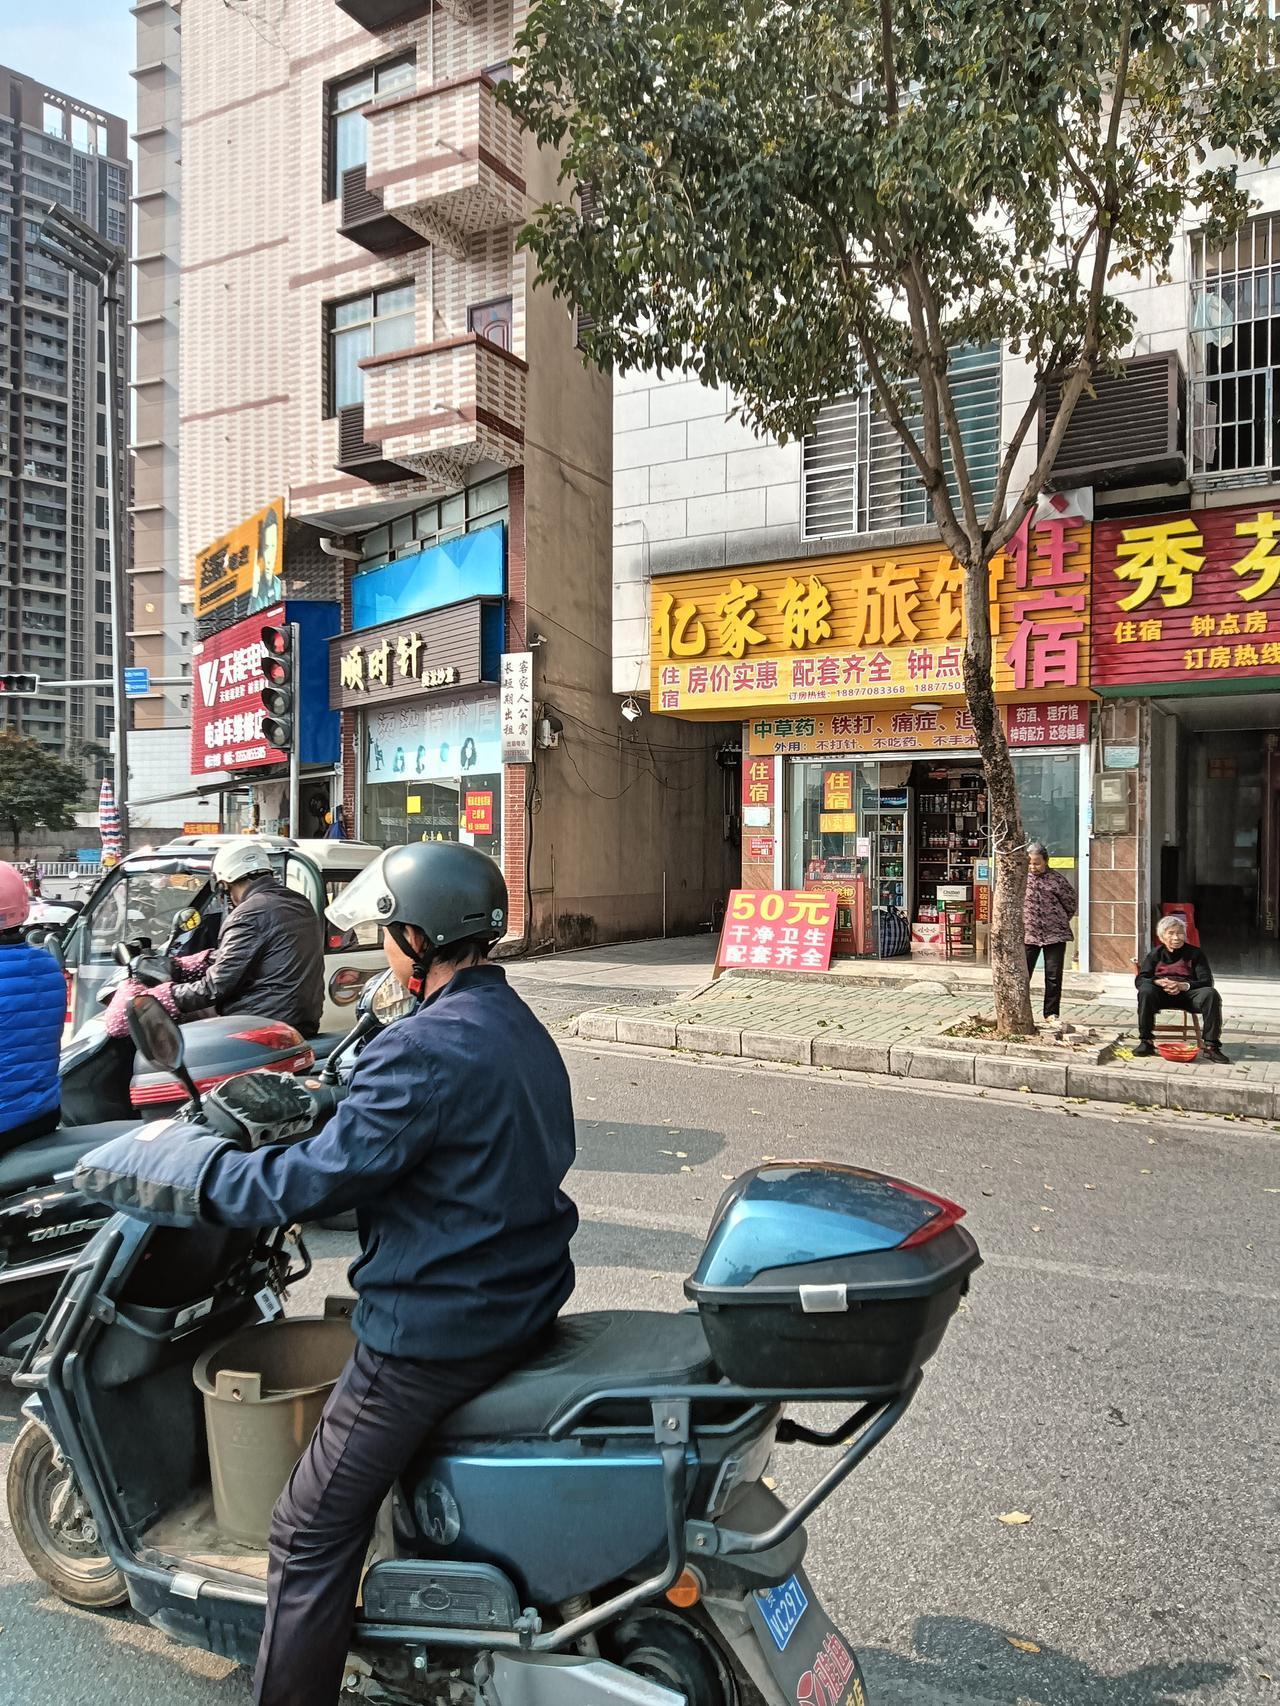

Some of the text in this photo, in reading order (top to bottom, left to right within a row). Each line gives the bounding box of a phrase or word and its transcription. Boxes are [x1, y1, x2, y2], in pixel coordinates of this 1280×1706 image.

[1003, 494, 1085, 688] 住宿
[1113, 610, 1268, 643] 住宿 钟点房
[219, 640, 269, 687] 天能电
[340, 631, 423, 691] 顺时针
[687, 646, 961, 694] 房价实惠 配套齐全 钟点
[1184, 642, 1280, 670] 订房热线
[503, 662, 514, 735] 长短期出租
[517, 661, 530, 736] 客家人公寓
[661, 667, 680, 708] 住宿
[914, 682, 967, 692] 1887750
[754, 707, 1003, 739] 中草药：铁打、痛症、追
[1010, 723, 1085, 742] 神奇配方 还您健康
[749, 762, 769, 802] 住宿
[827, 772, 850, 809] 住宿
[732, 893, 830, 926] 50元
[729, 925, 826, 947] 干净卫生
[725, 945, 825, 967] 配套齐全
[770, 1582, 803, 1640] VC297
